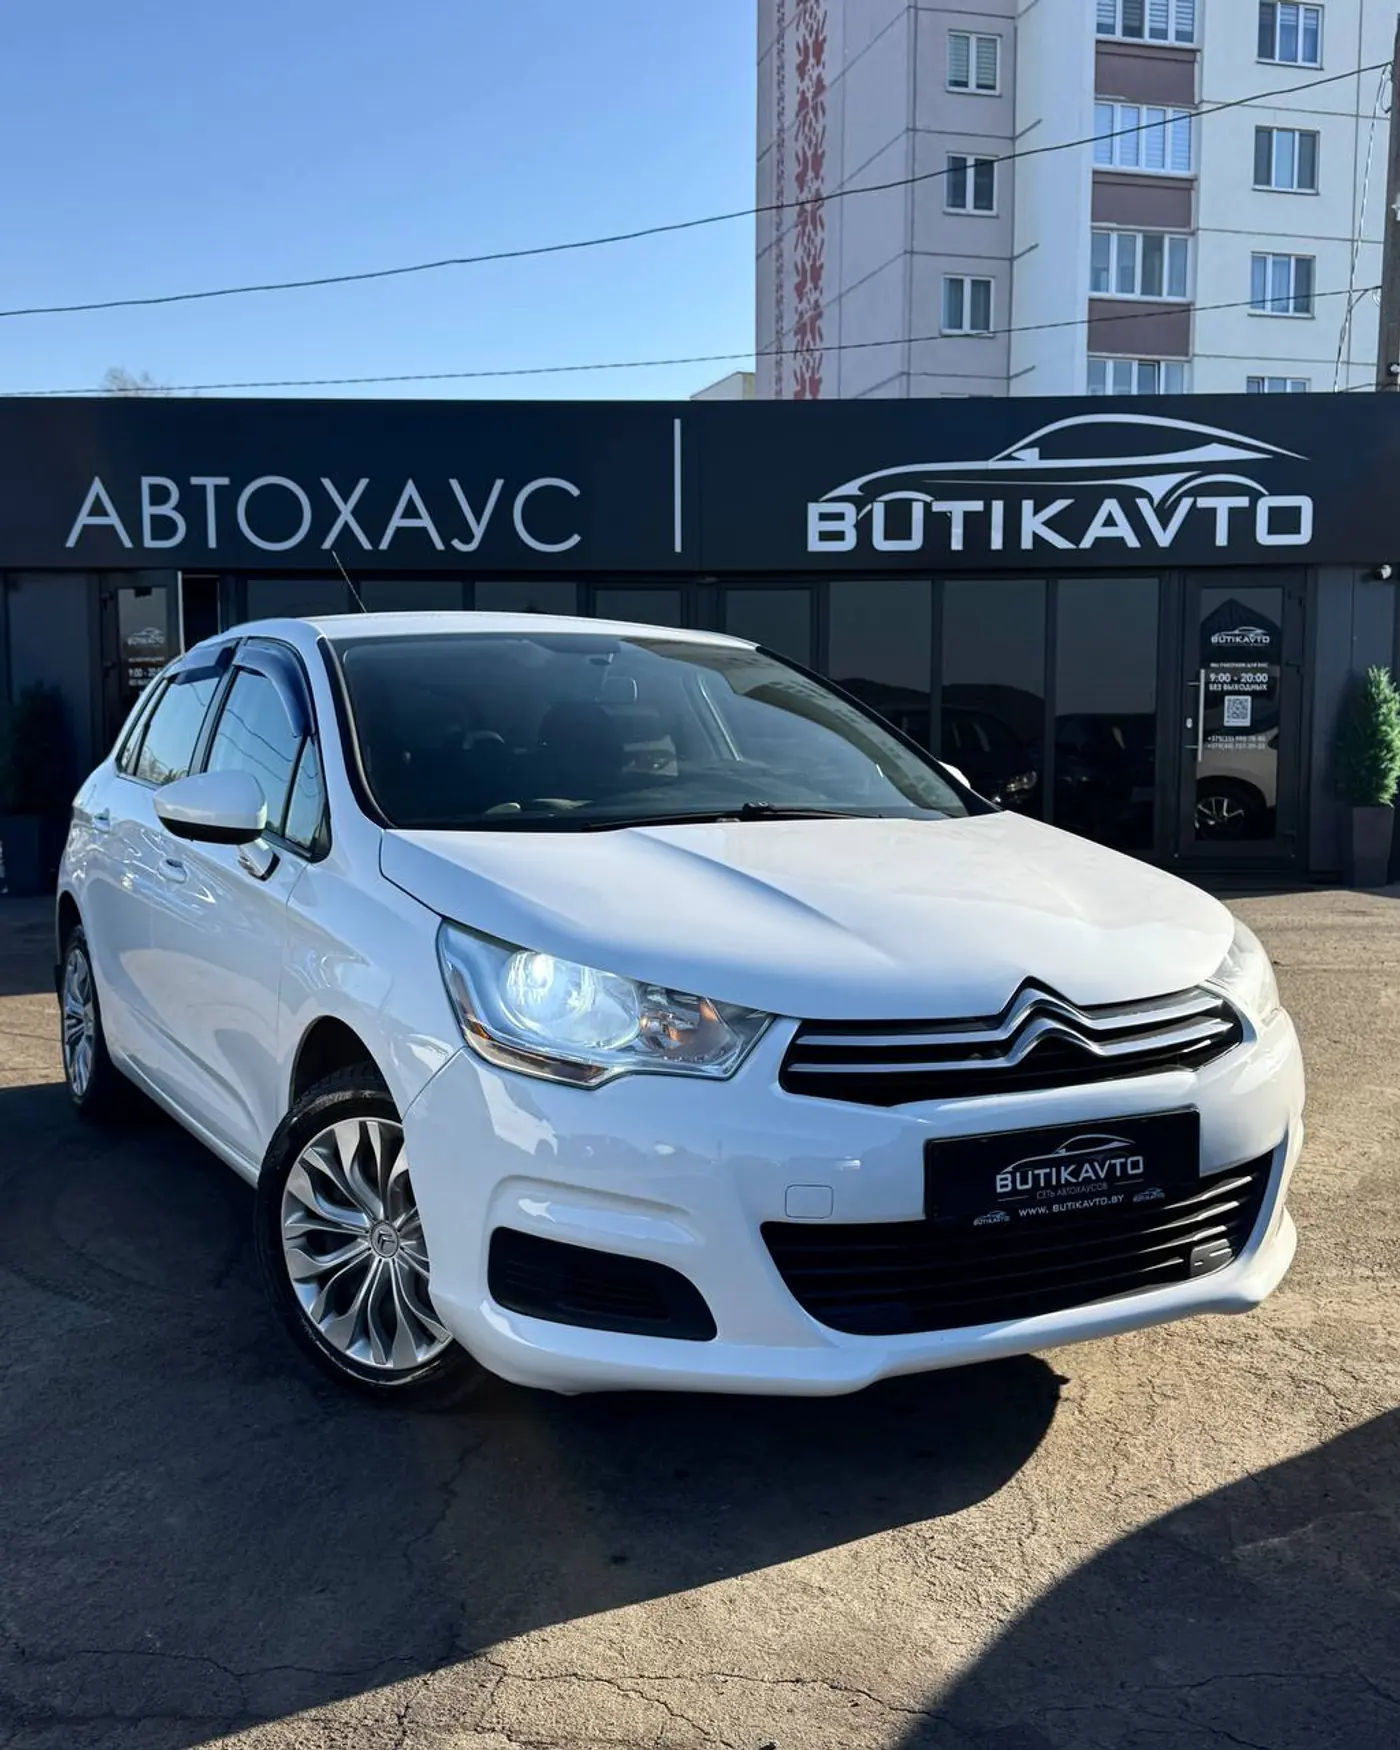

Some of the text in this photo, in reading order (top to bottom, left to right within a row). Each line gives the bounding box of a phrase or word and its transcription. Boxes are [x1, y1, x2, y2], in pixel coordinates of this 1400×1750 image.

[65, 475, 582, 553] АВТОХАУС
[807, 495, 1314, 553] BUTIKAVTO
[1209, 672, 1231, 683] 9:00
[1240, 672, 1269, 683] 20:00
[995, 1155, 1145, 1194] BUTIKAVTO
